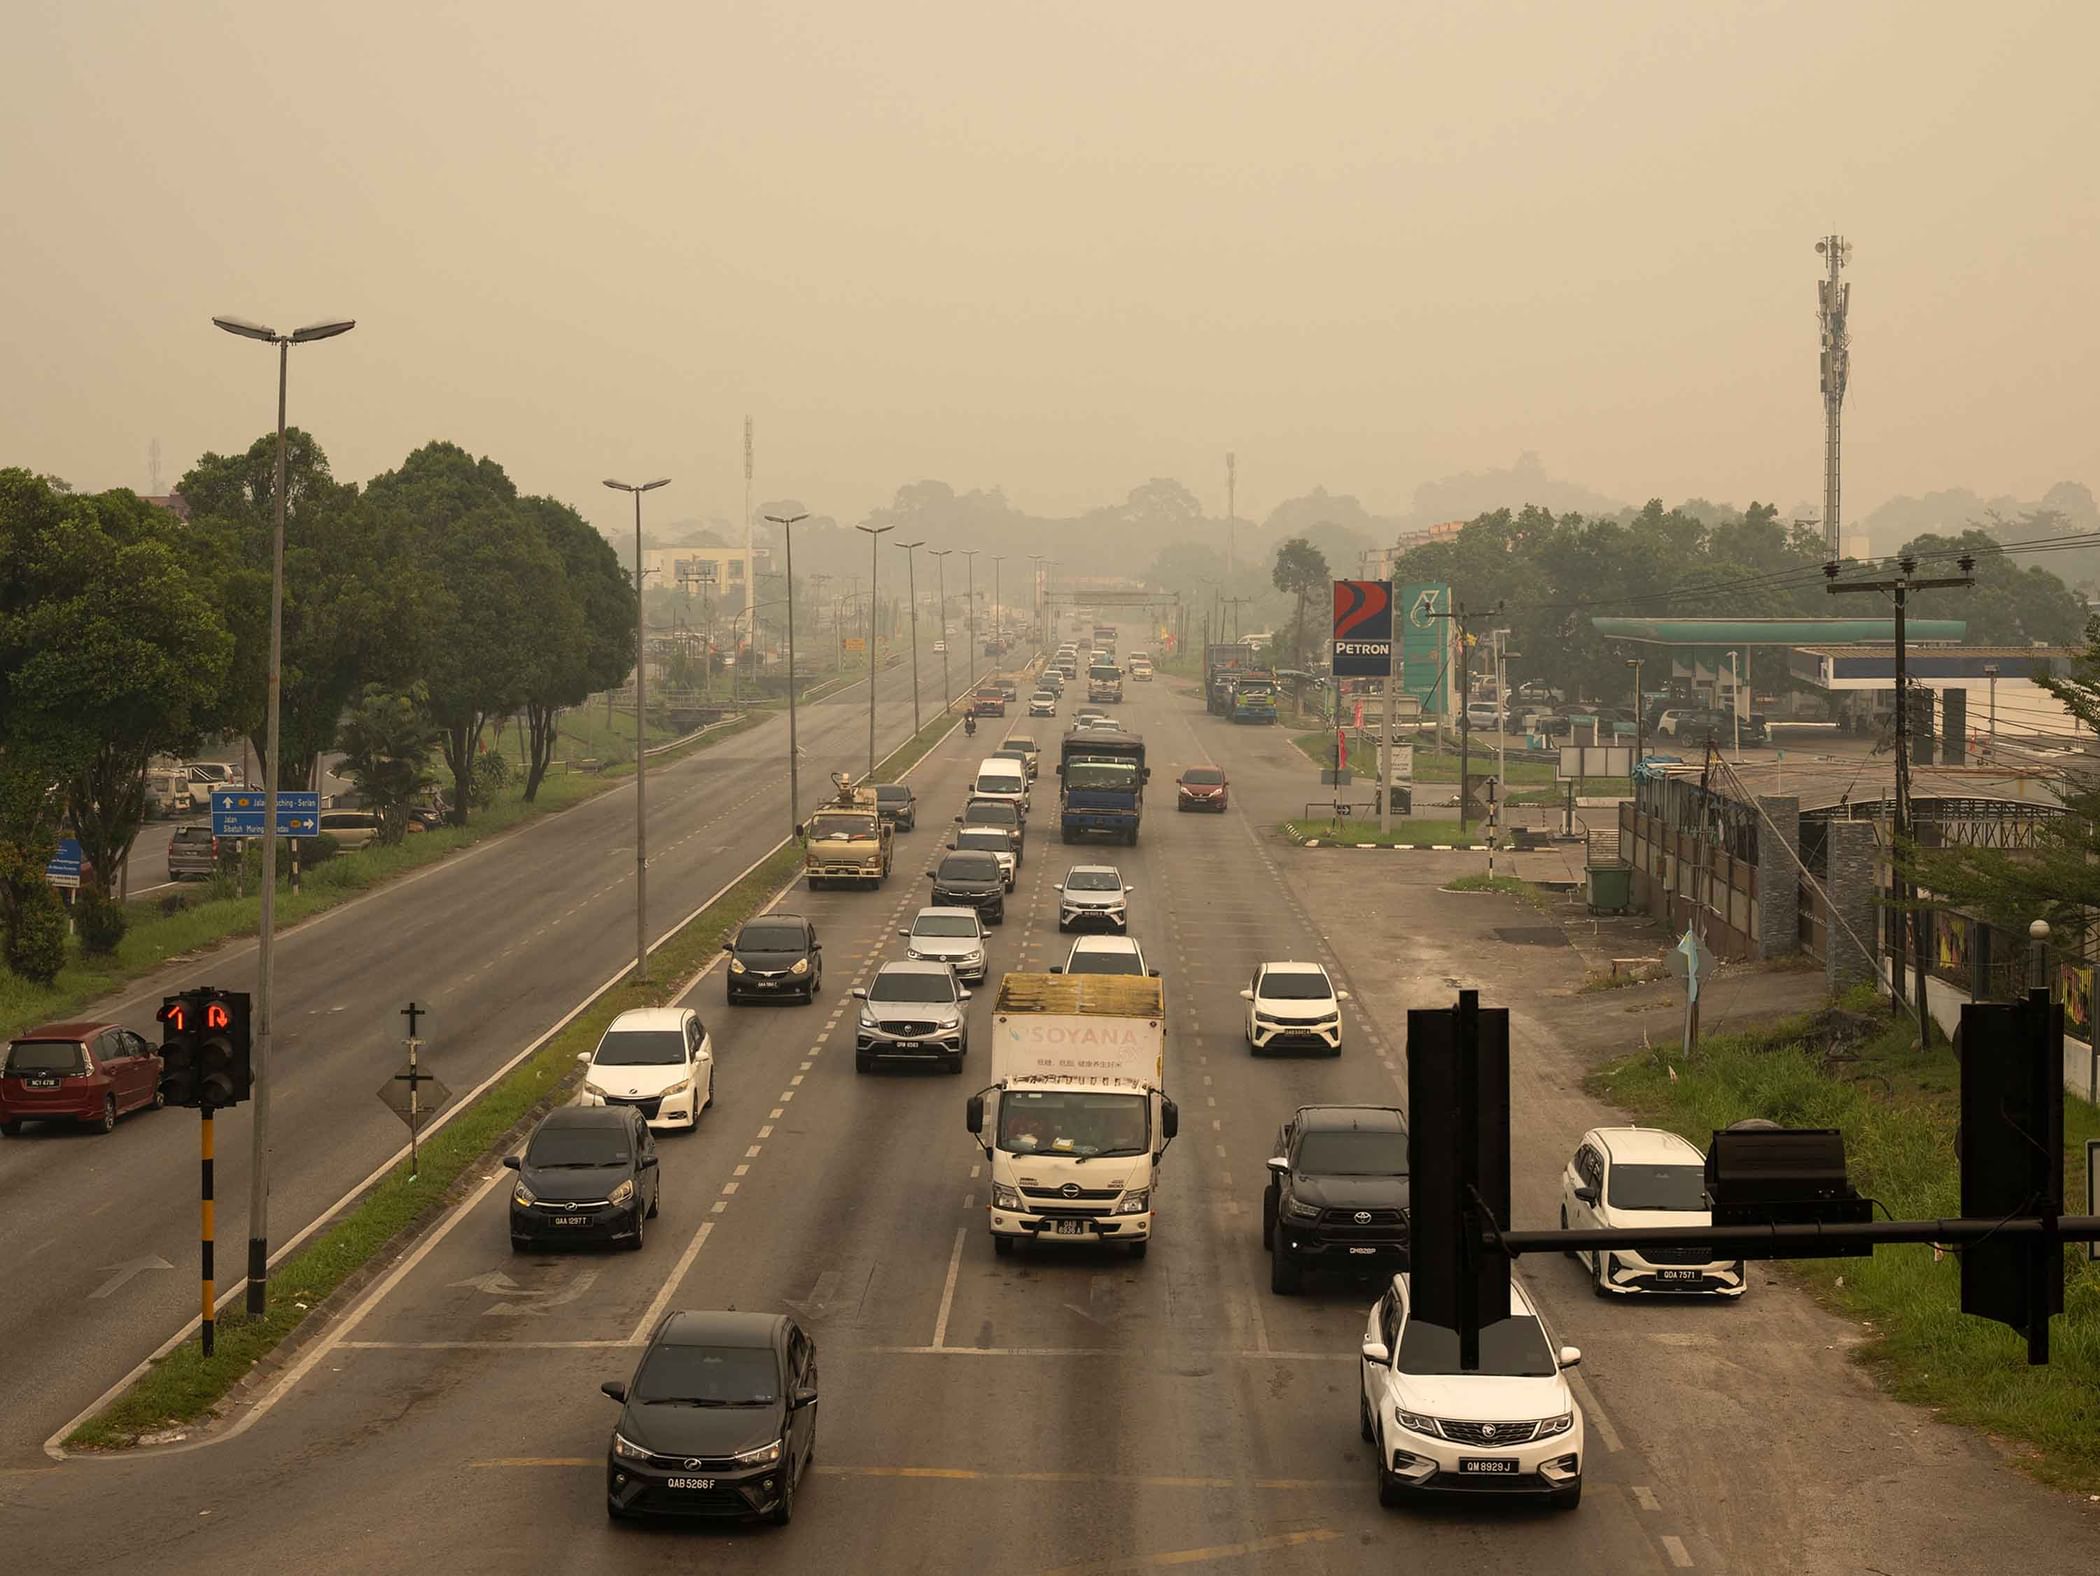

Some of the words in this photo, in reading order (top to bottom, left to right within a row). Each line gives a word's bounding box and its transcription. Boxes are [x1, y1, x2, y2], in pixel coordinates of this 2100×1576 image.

[1336, 642, 1389, 654] PETRON
[1030, 1027, 1137, 1045] SOYANA
[1679, 1271, 1695, 1279] 7571
[1467, 1462, 1480, 1472] QM
[1480, 1462, 1503, 1472] 8929
[1504, 1463, 1511, 1472] J
[667, 1478, 685, 1488] QAB
[686, 1478, 709, 1489] 5266
[709, 1480, 715, 1489] F
